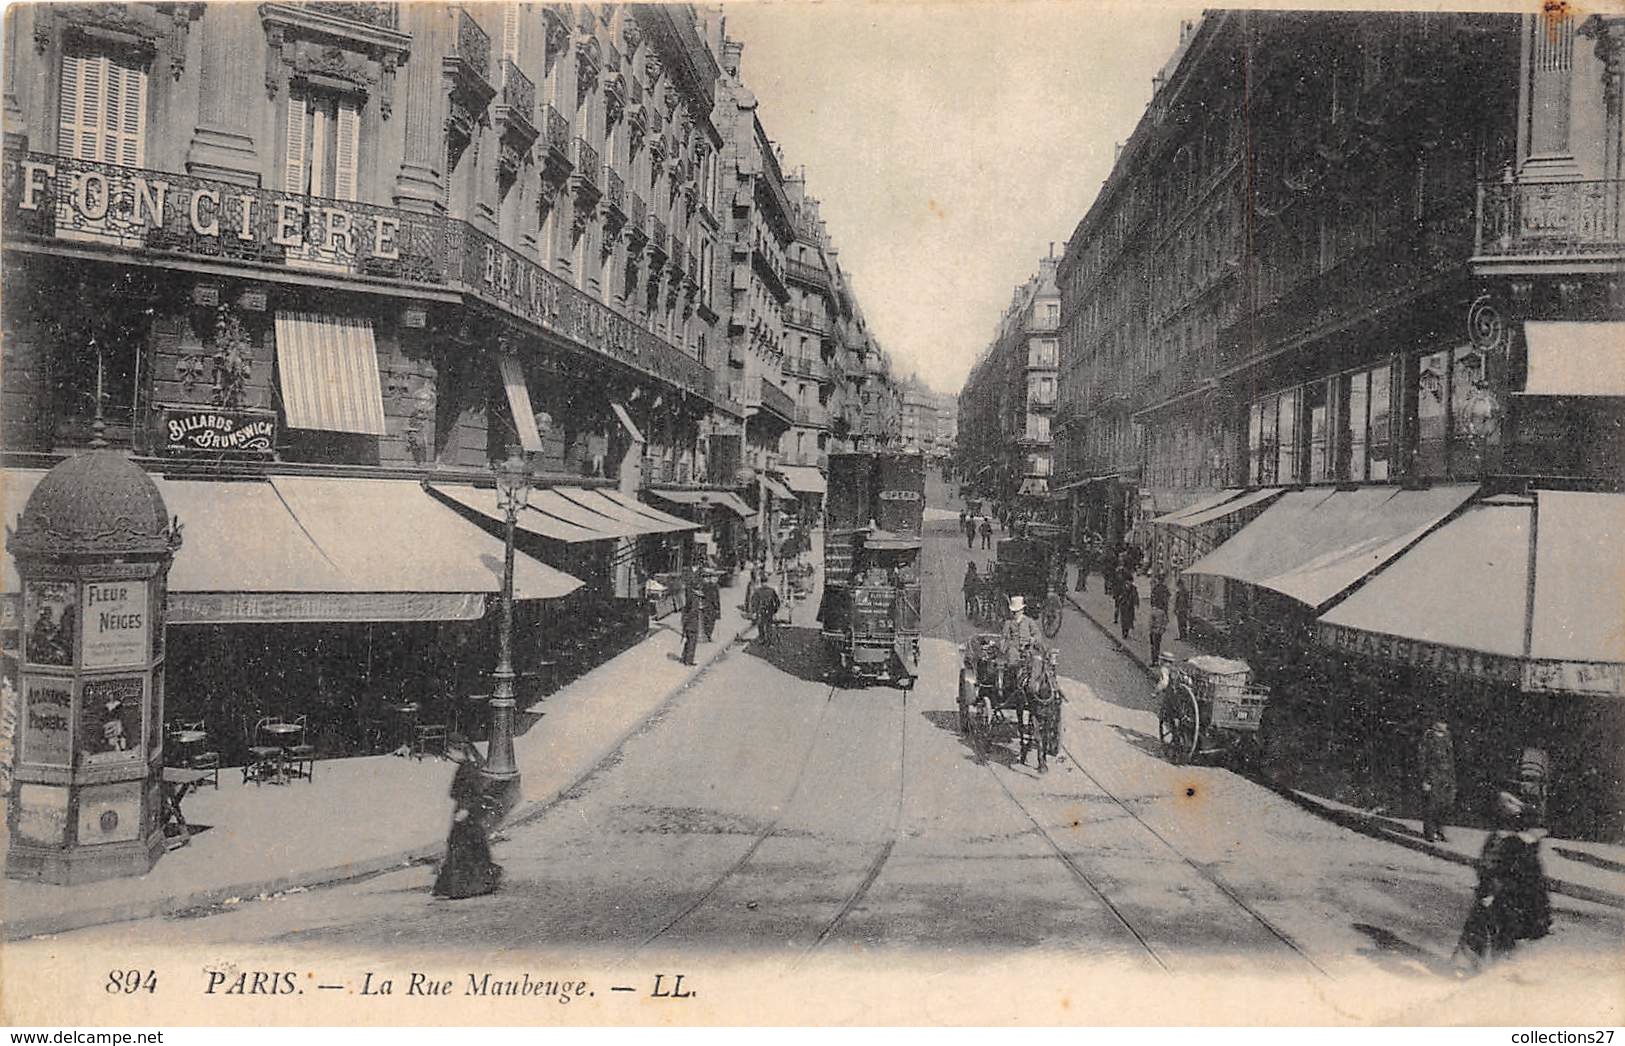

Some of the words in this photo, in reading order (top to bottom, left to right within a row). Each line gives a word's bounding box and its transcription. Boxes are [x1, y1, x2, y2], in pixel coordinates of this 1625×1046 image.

[18, 160, 400, 260] FONCIERE
[168, 415, 233, 441] BILLARDS
[188, 421, 274, 448] BRUNSWICK
[88, 585, 128, 606] FLEUR
[99, 613, 142, 633] NEIGES
